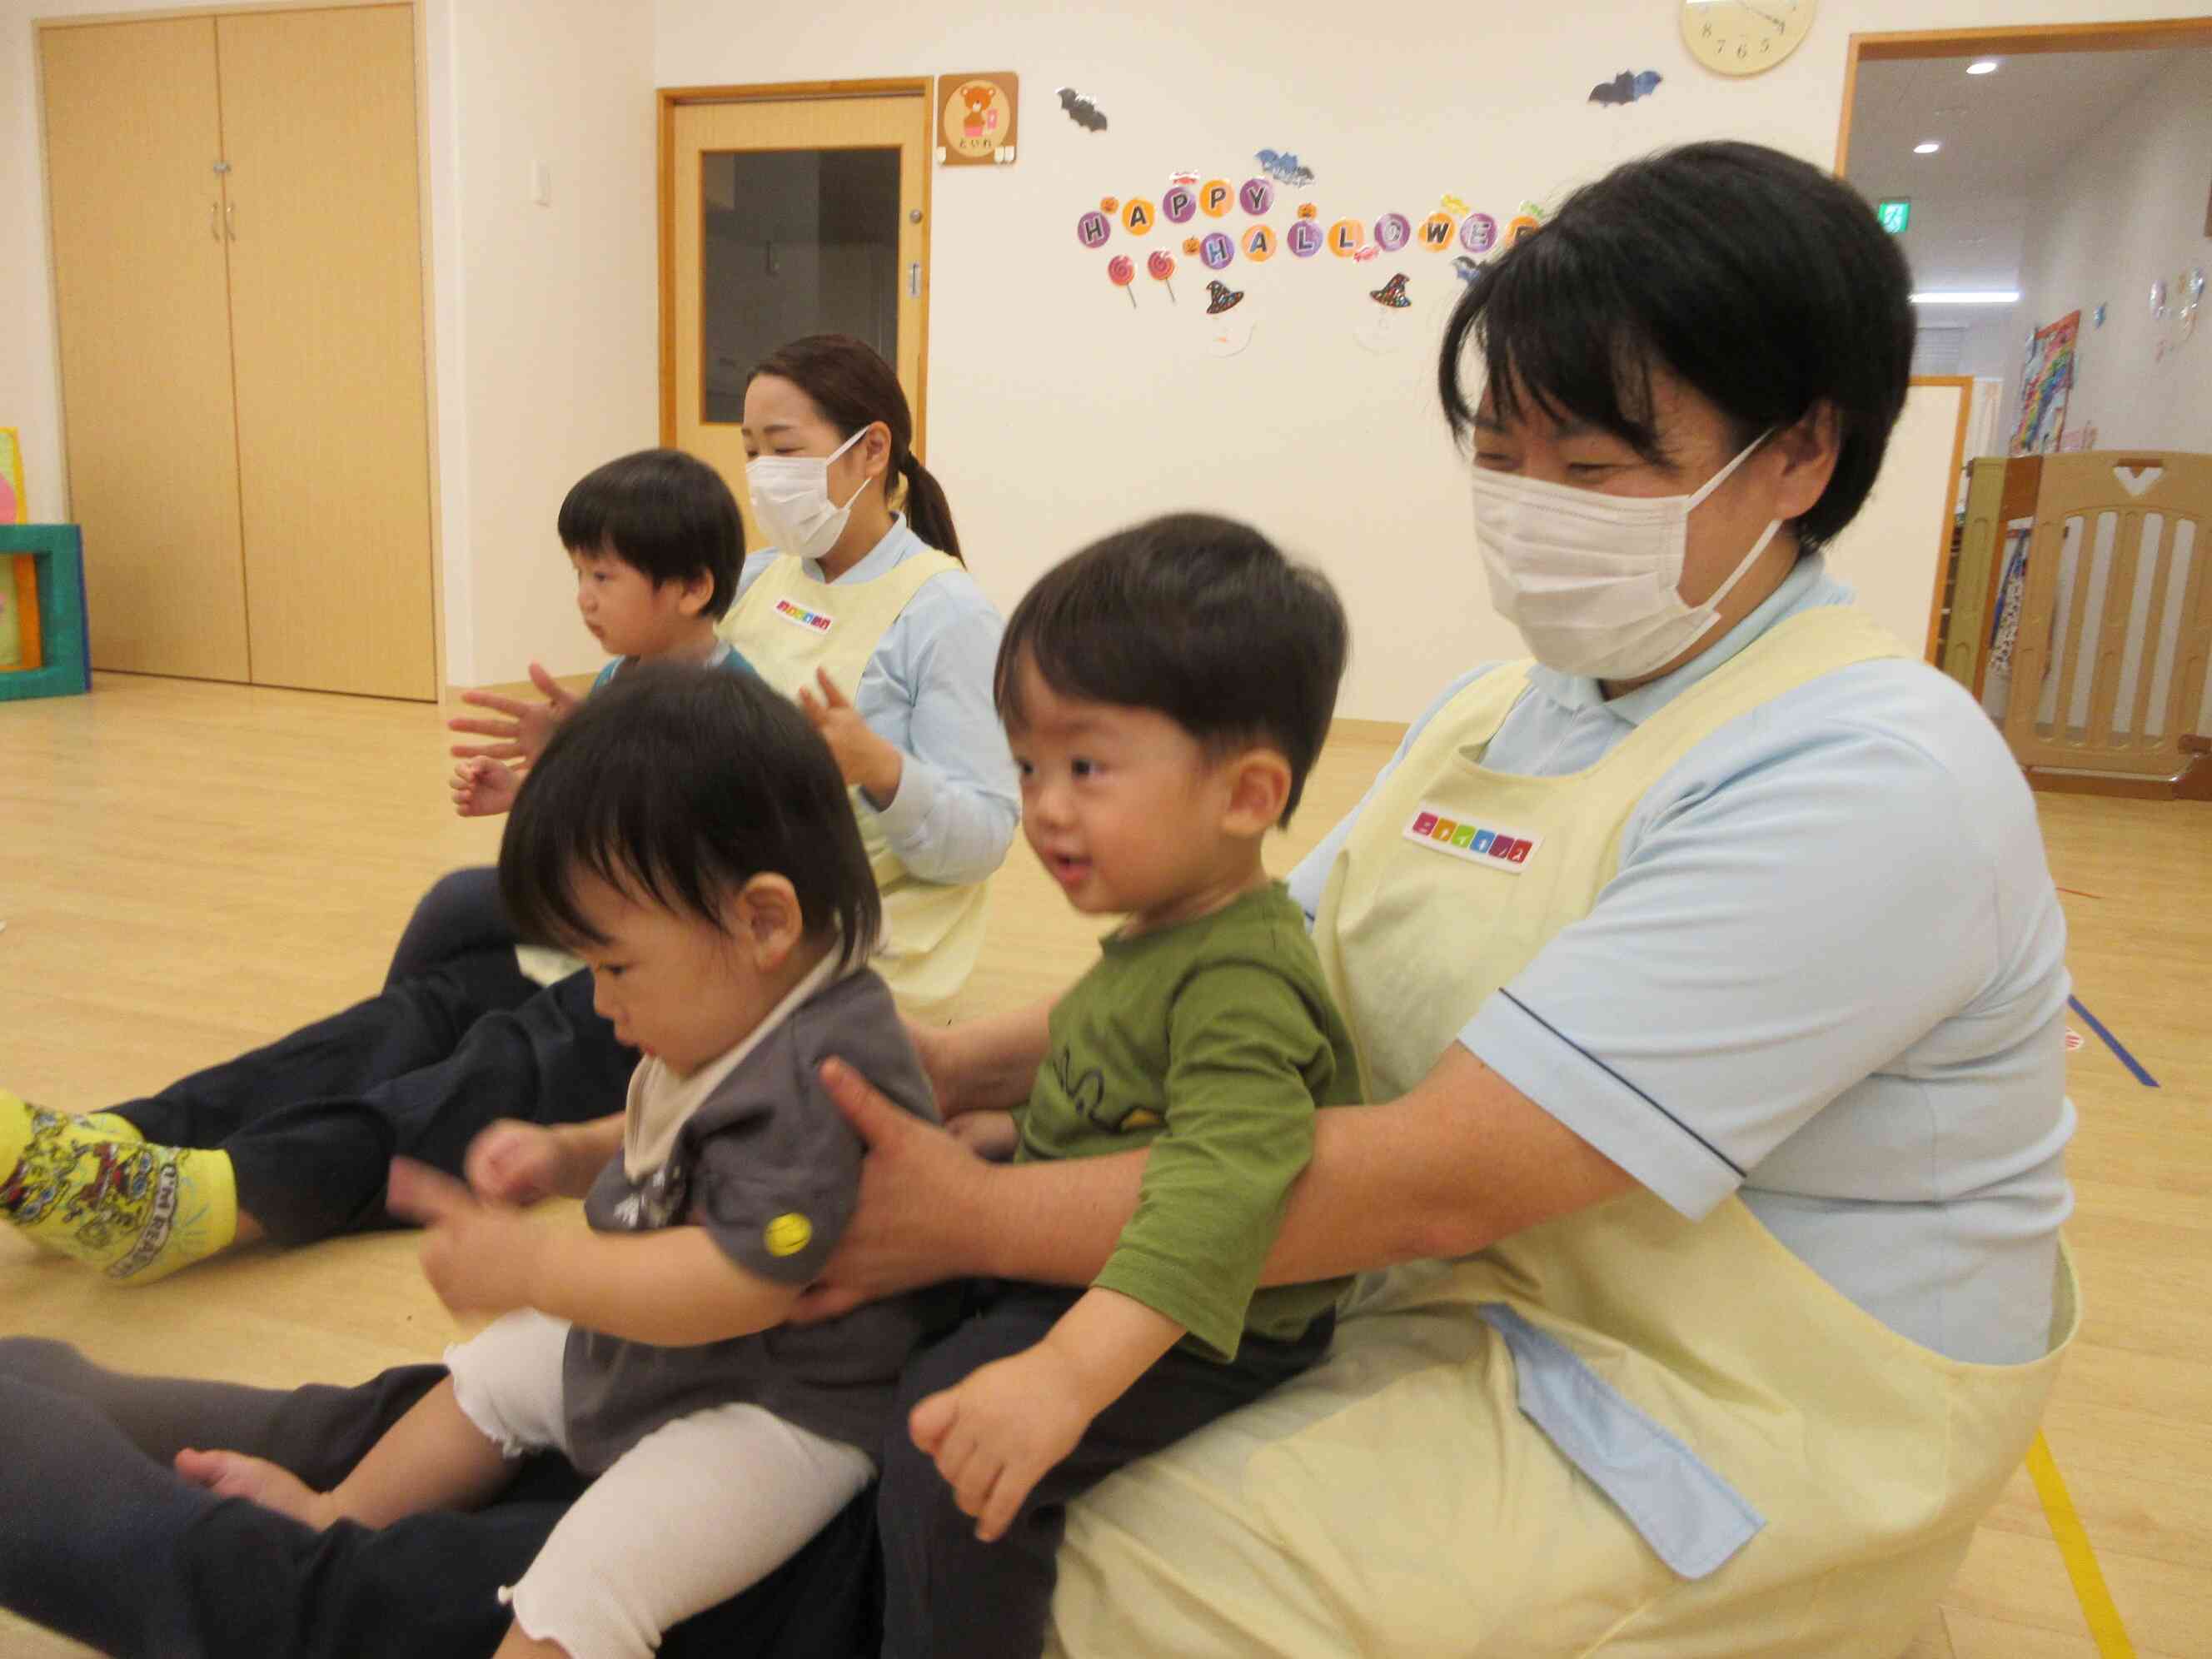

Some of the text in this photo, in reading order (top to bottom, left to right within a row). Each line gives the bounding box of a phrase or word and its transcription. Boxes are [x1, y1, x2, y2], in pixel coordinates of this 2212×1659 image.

[1716, 39, 1726, 54] 7
[1736, 44, 1747, 59] 6
[1759, 38, 1771, 53] 5
[1084, 187, 1266, 242] HAPPY
